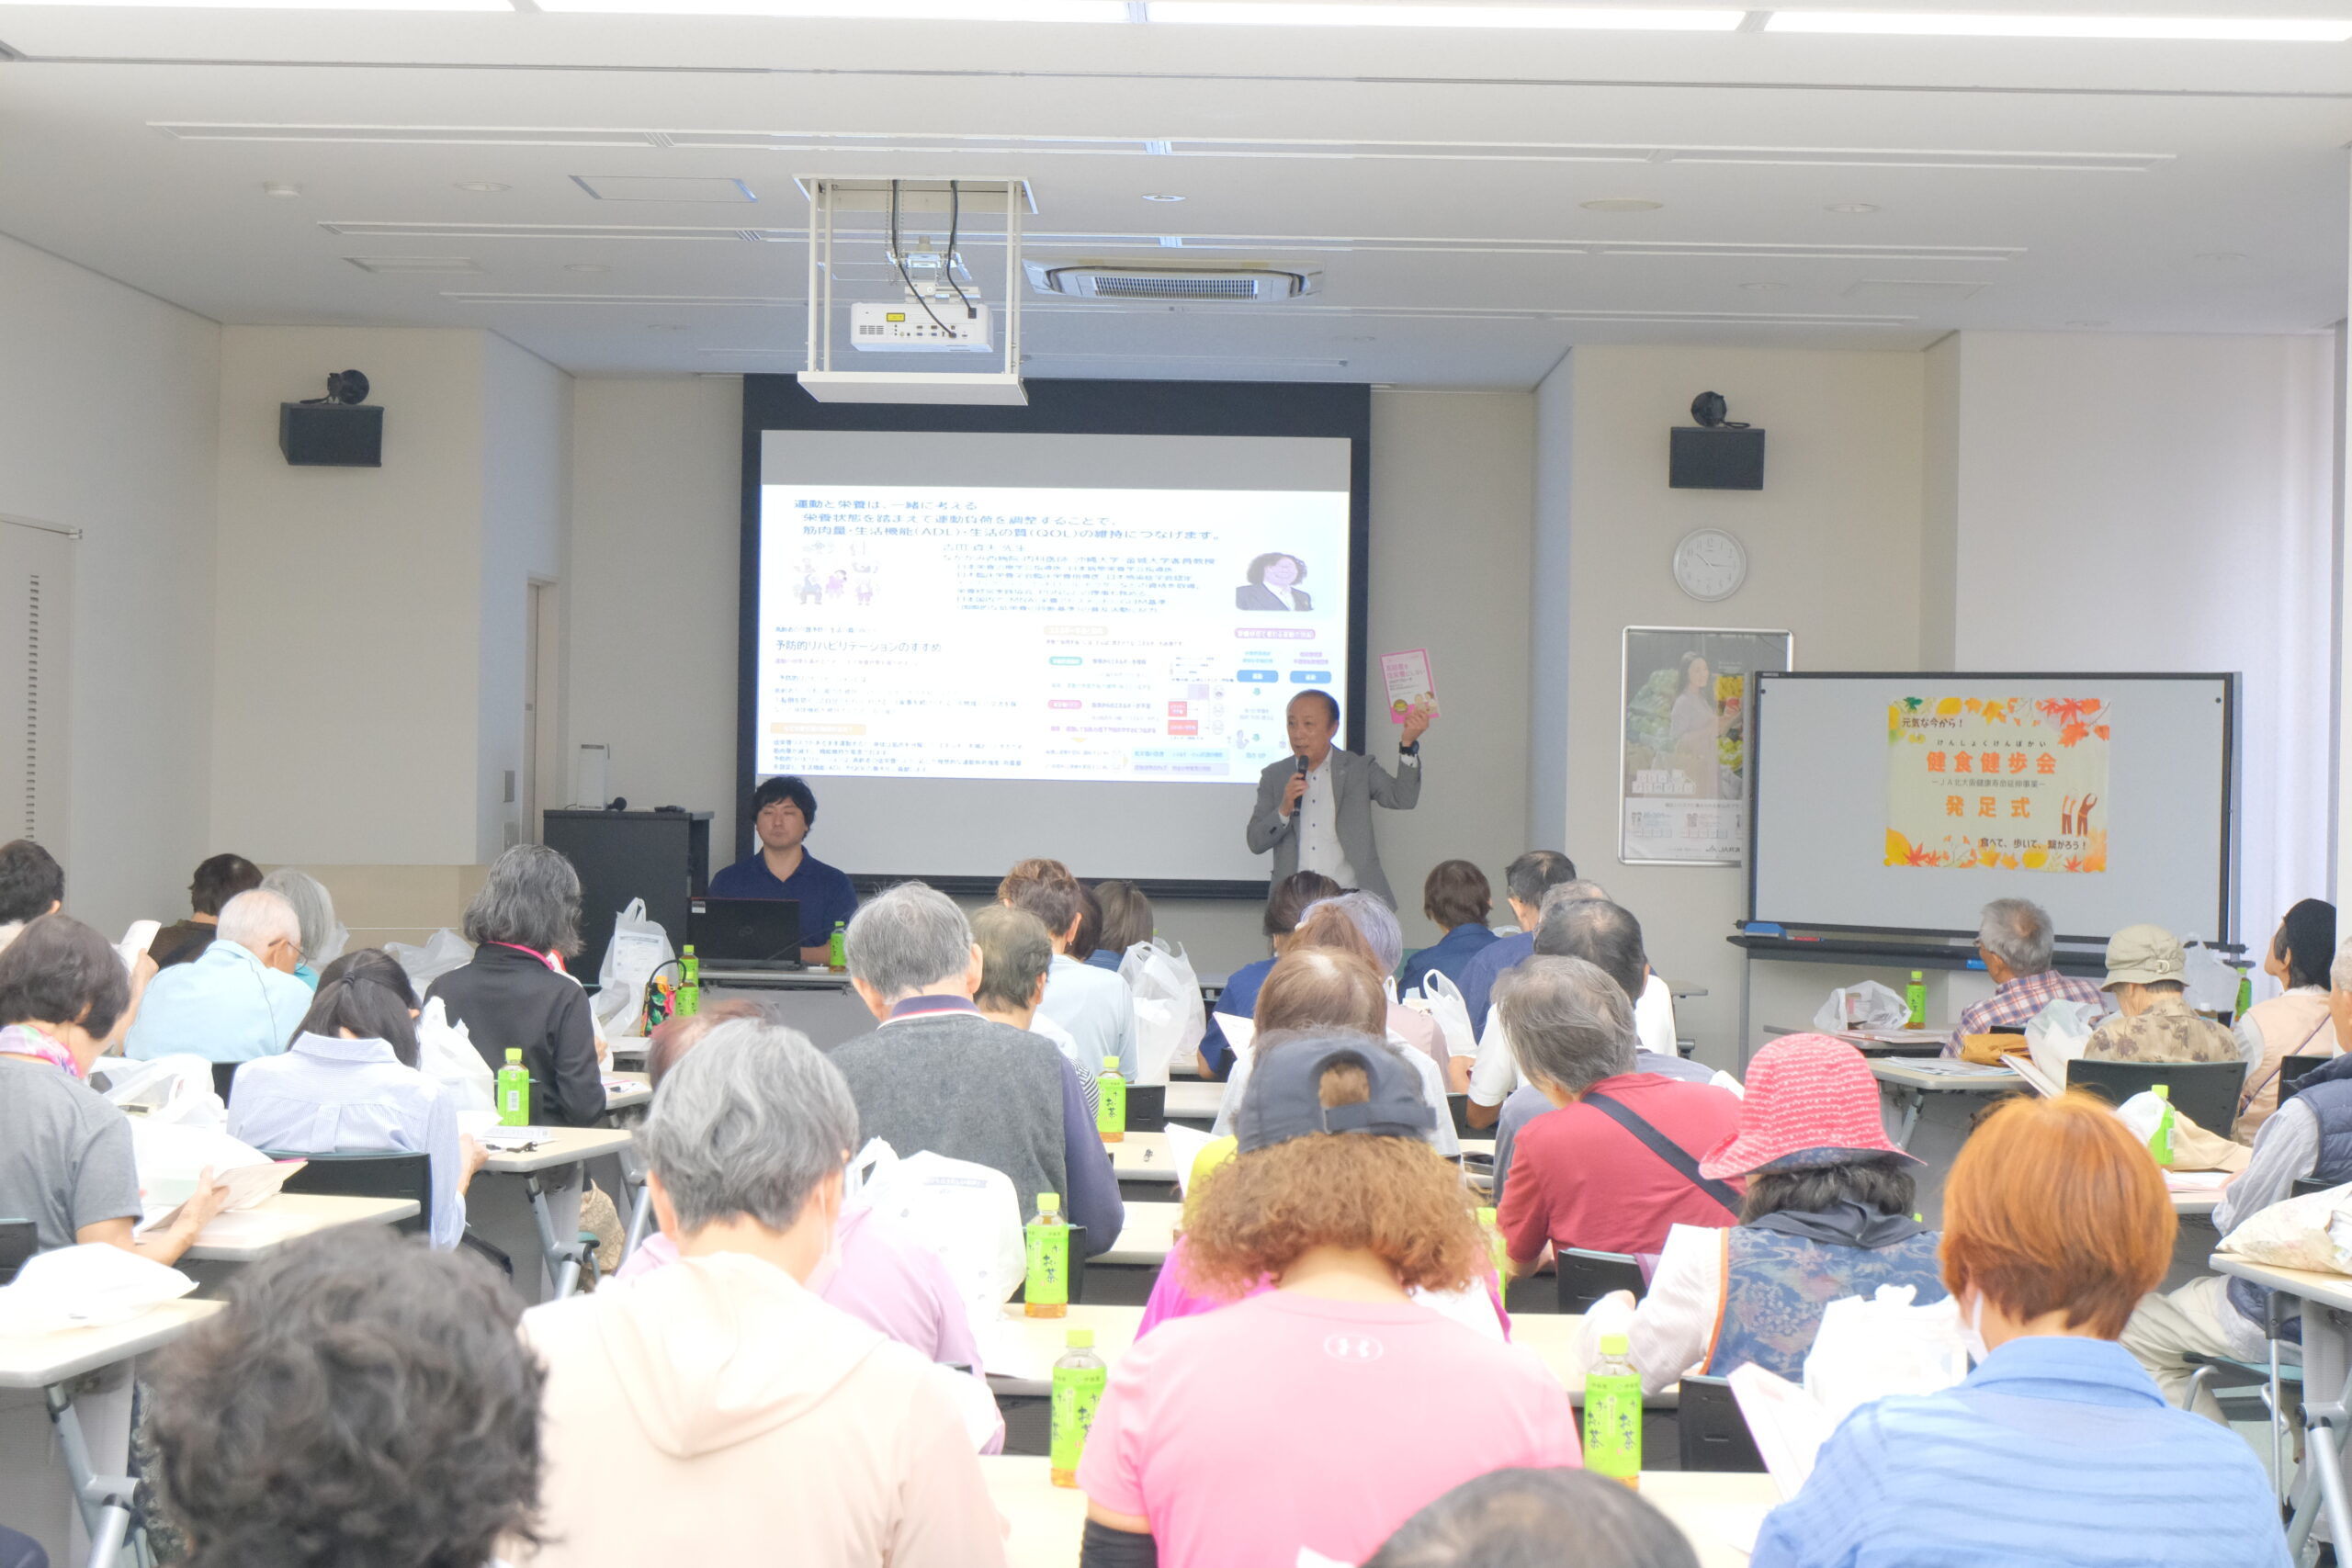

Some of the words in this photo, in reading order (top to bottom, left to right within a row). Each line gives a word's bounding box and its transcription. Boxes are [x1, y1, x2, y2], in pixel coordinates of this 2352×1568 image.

[775, 639, 942, 652] 予防的リハビリテーションのすすめ
[1926, 750, 2057, 774] 健食健歩会
[1945, 795, 2031, 818] 発足式
